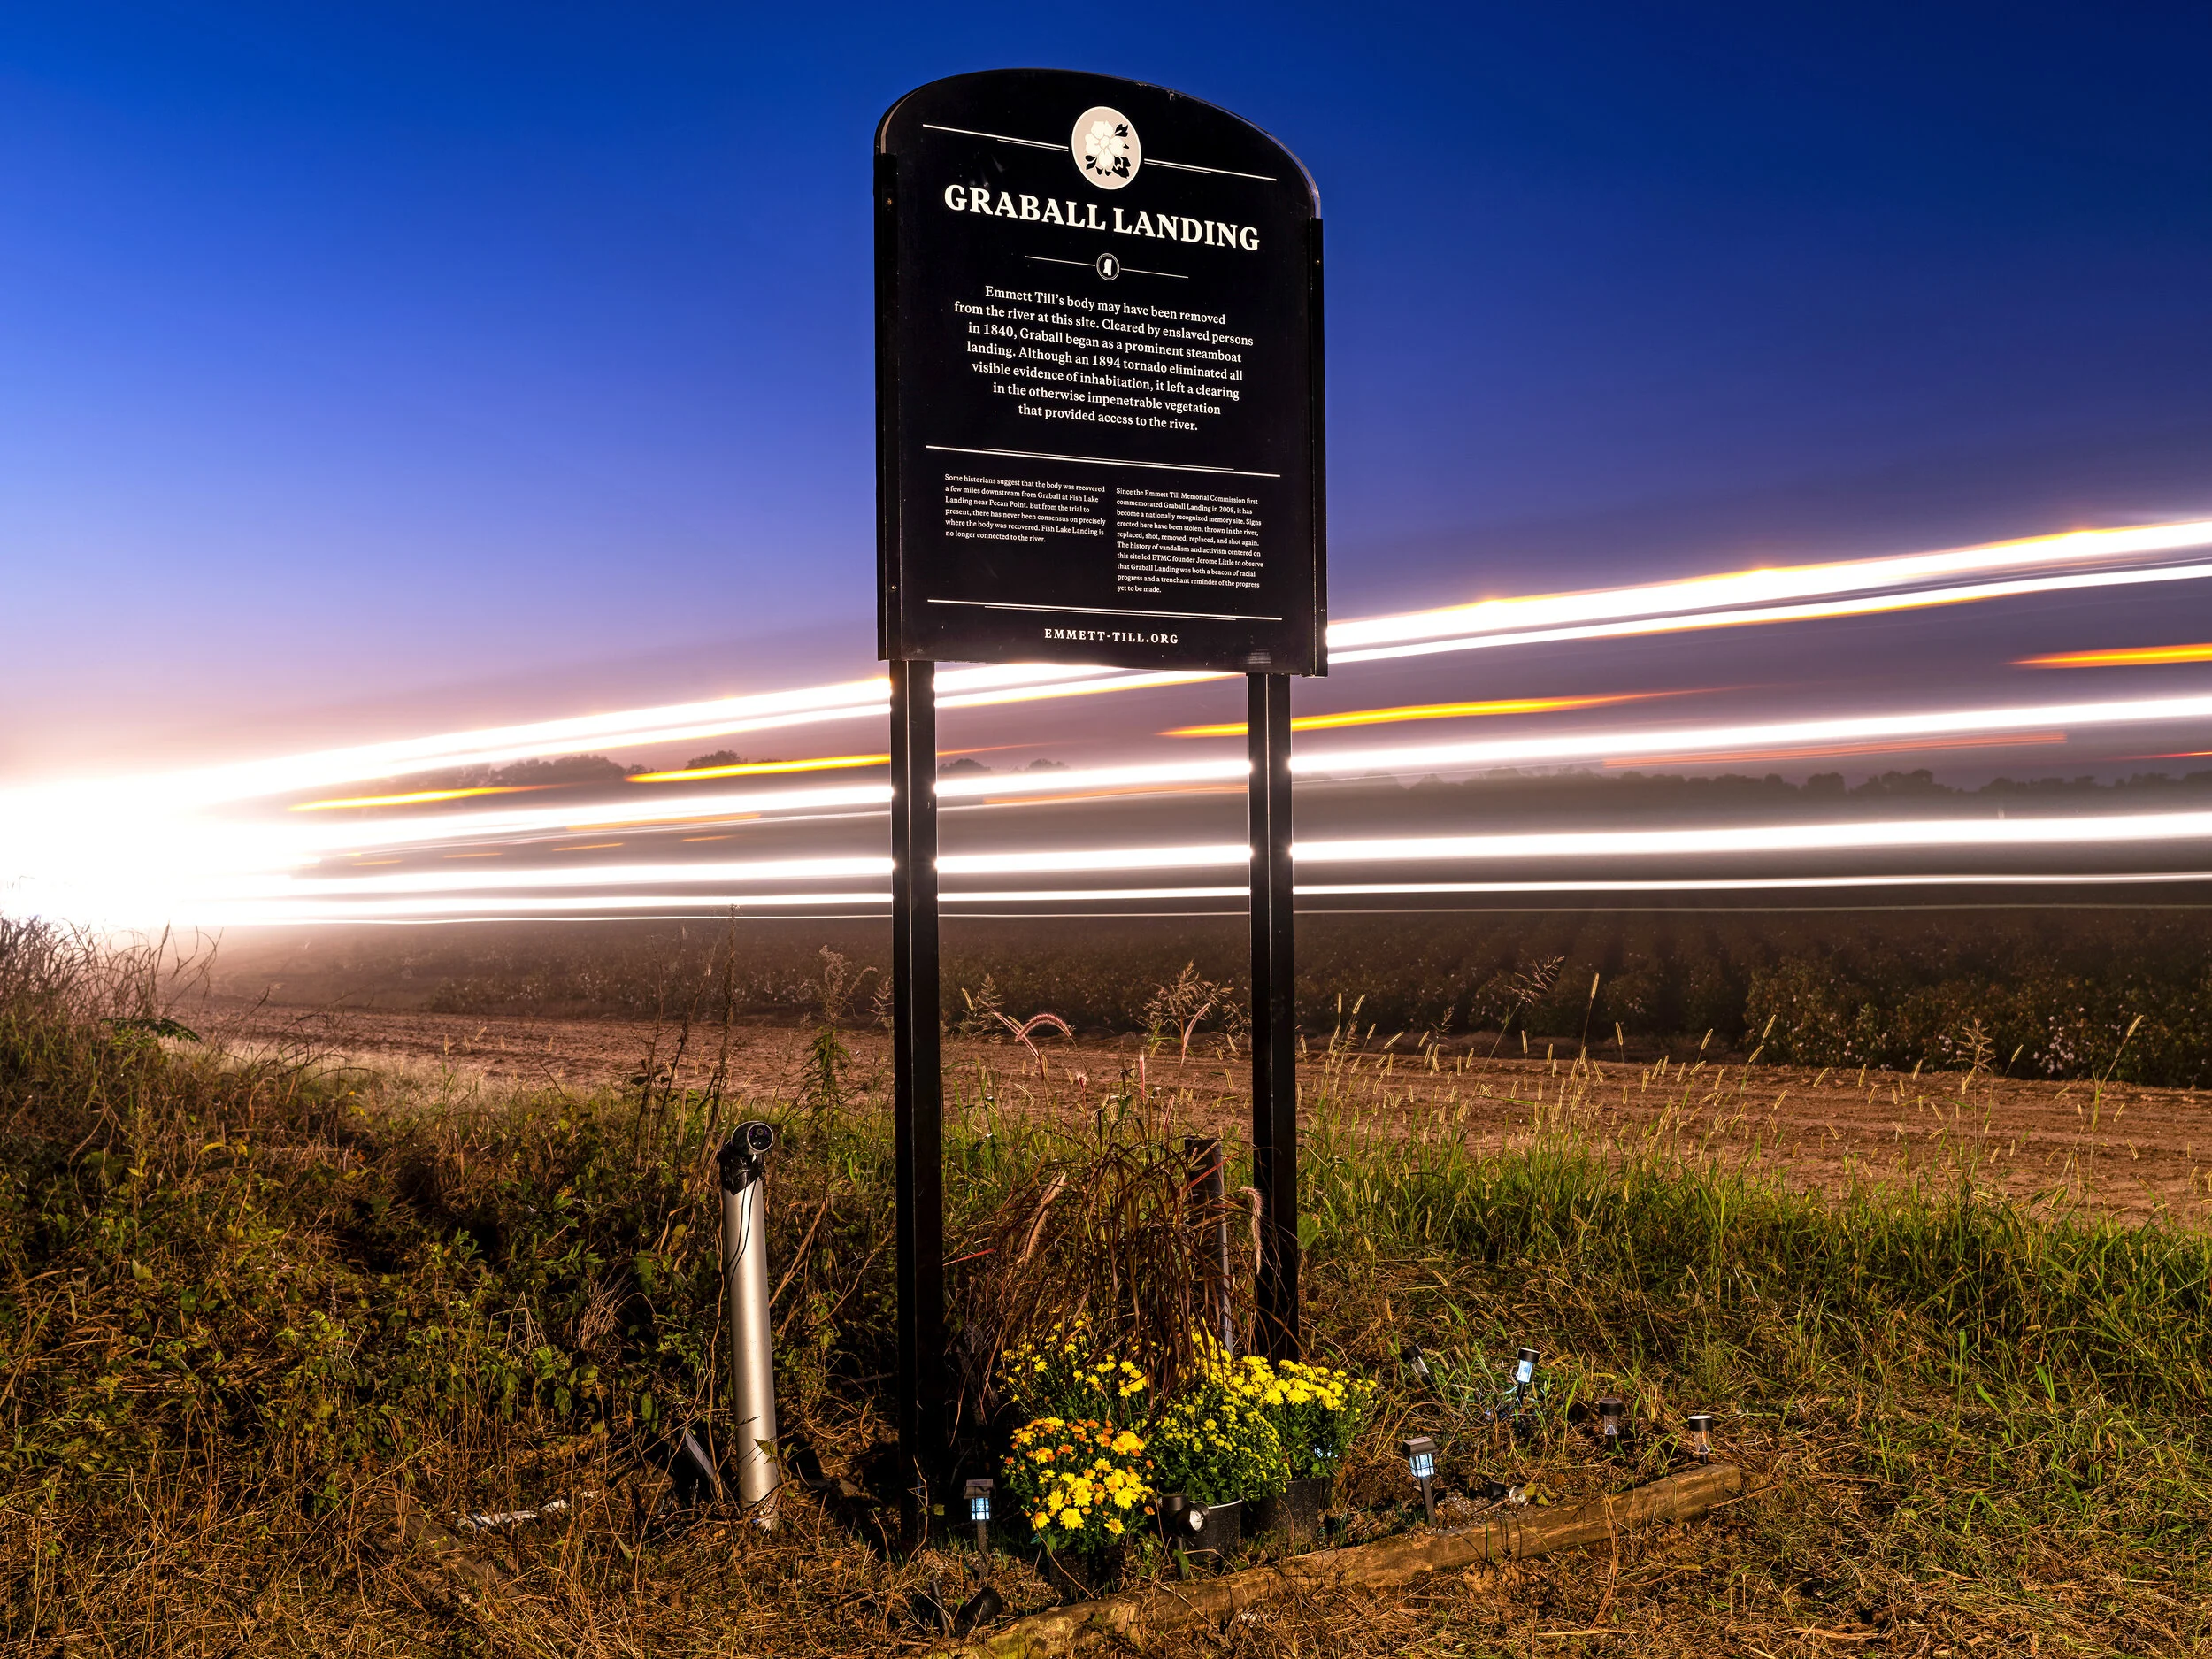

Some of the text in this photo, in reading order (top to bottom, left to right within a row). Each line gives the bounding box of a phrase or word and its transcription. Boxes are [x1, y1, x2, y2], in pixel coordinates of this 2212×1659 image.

[944, 184, 1261, 251] GRABALL LANDING
[985, 285, 1033, 302] Emmett
[1066, 296, 1095, 312] body
[1097, 302, 1121, 315] may
[1123, 302, 1148, 316] have
[1150, 305, 1178, 319] been
[1179, 312, 1226, 325] removed
[954, 301, 1254, 346] from the river at this site. Cleared by enslaved persons
[968, 321, 1241, 363] in 1840, Graball began as a prominent steamboat
[967, 341, 1243, 381] landing. Although an 1894 tornado eliminated all
[972, 361, 1011, 375] visible
[1013, 365, 1064, 381] evidence
[1066, 371, 1079, 382] of
[1079, 372, 1154, 392] inhabitation,
[1156, 380, 1164, 391] it
[1166, 380, 1186, 394] left
[1195, 384, 1240, 402] clearing
[993, 381, 1221, 415] in the otherwise impenetrable vegetation
[1018, 403, 1198, 431] that provided access to the river.
[964, 474, 996, 485] historians
[996, 479, 1020, 488] suggest
[1046, 481, 1063, 491] body
[945, 495, 973, 506] Landing
[1009, 500, 1028, 509] Point.
[980, 488, 1020, 497] downstream
[1037, 491, 1061, 500] Graball
[1144, 489, 1169, 498] Emmett
[1180, 492, 1210, 501] Memorial
[1210, 495, 1246, 503] Commission
[1116, 499, 1163, 508] commemorated
[1187, 503, 1211, 513] Landing
[1218, 505, 1236, 514] 2008,
[1145, 511, 1176, 521] nationally
[1209, 517, 1233, 526] memory
[1246, 518, 1262, 527] Signs
[955, 530, 976, 540] longer
[978, 520, 995, 530] body
[1071, 526, 1098, 537] Landing
[1243, 528, 1259, 537] river,
[1117, 531, 1145, 540] replaced,
[1145, 532, 1161, 541] shot,
[1189, 535, 1216, 544] replaced,
[1241, 539, 1259, 548] again.
[1171, 555, 1195, 564] founder
[1130, 563, 1154, 572] Graball
[1154, 565, 1179, 574] Landing
[1044, 628, 1179, 644] EMMETT-TILL.ORG
